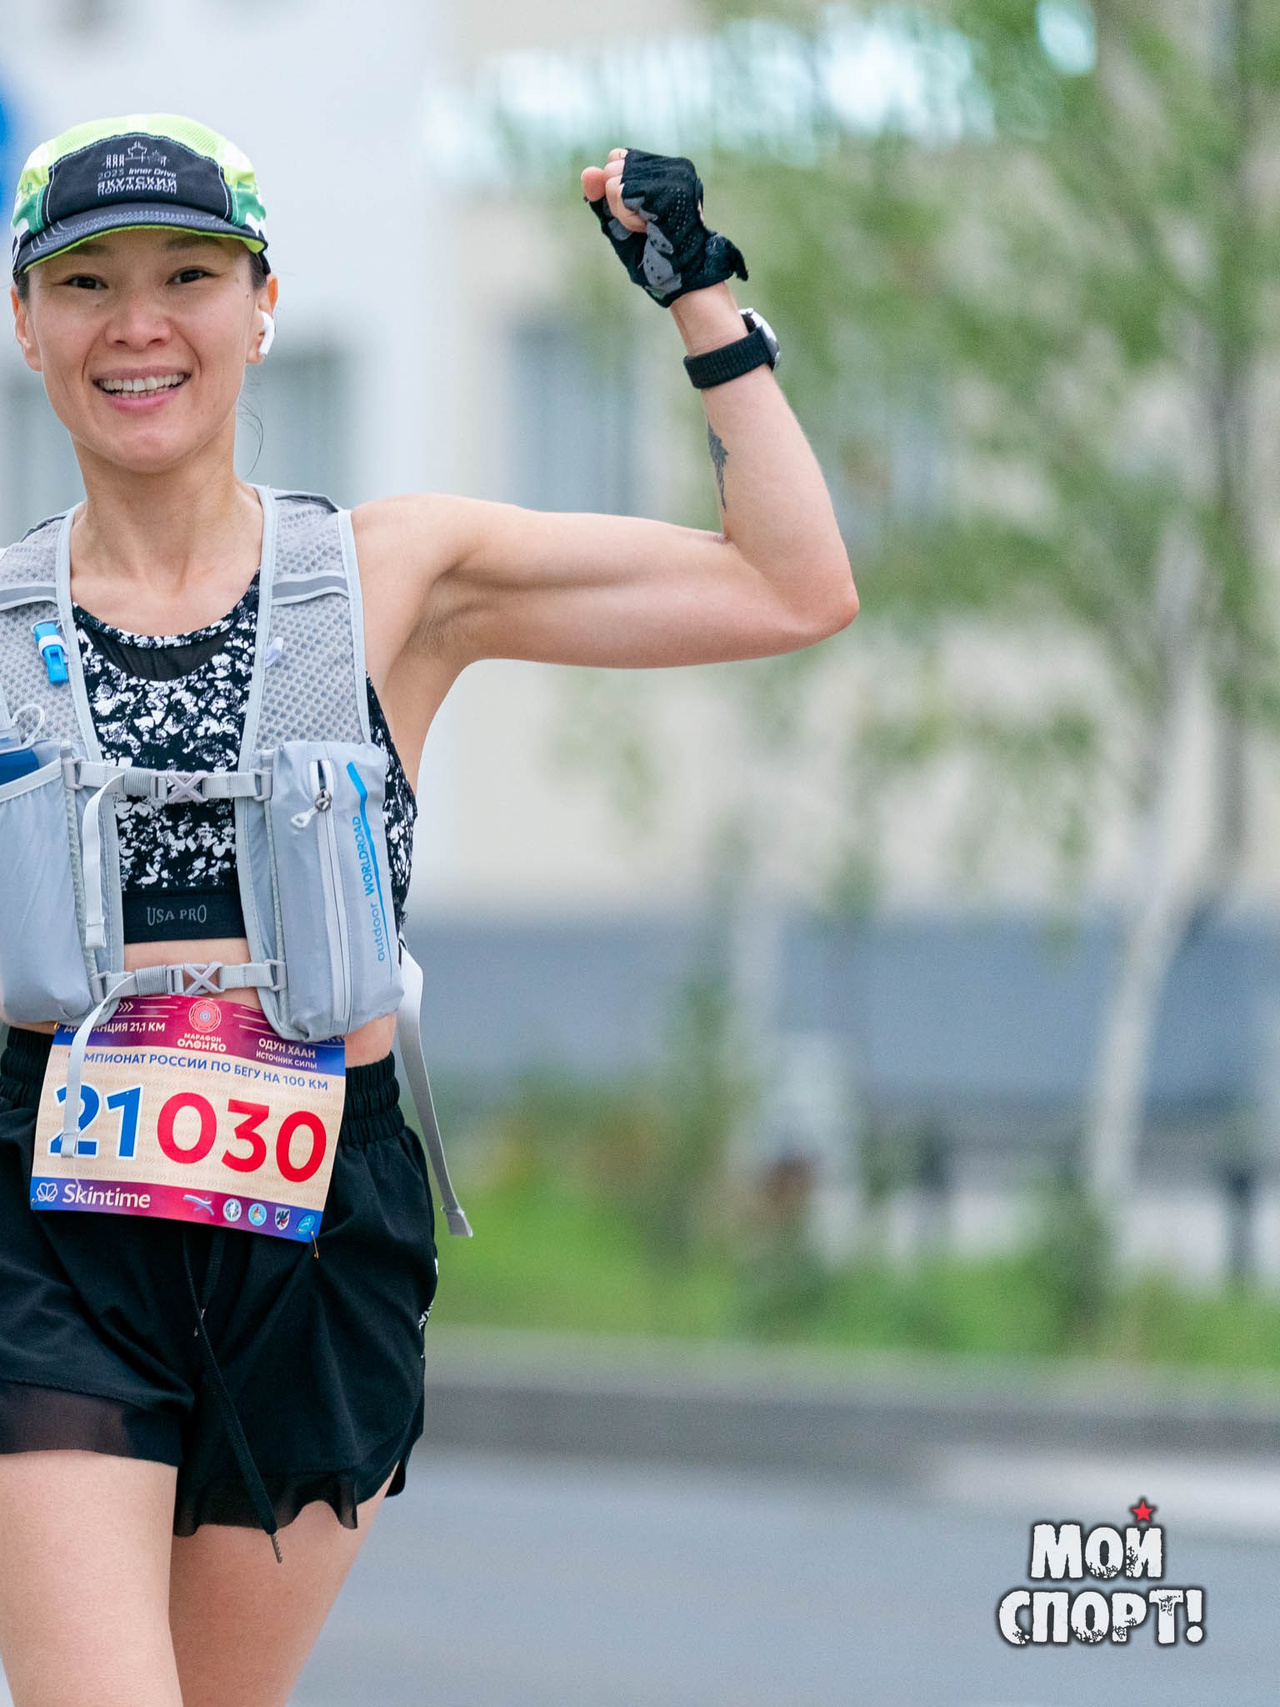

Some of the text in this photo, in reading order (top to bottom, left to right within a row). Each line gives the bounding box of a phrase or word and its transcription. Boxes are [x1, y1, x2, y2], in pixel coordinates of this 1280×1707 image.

[97, 176, 177, 189] ЯКУТСКИЙ
[352, 816, 386, 962] outdoor WORLDROAD
[146, 904, 207, 926] USA PRO
[129, 1022, 147, 1034] 21,1
[148, 1022, 166, 1032] КМ
[183, 1033, 222, 1044] МАРАФОН
[255, 1050, 293, 1066] ИСТОЧНИК
[258, 1038, 316, 1059] ОДУН ХААН
[68, 1052, 329, 1091] МПИОНАТ РОССИИ ПО БЕГУ НА 100 КМ
[61, 1183, 151, 1209] Skintime
